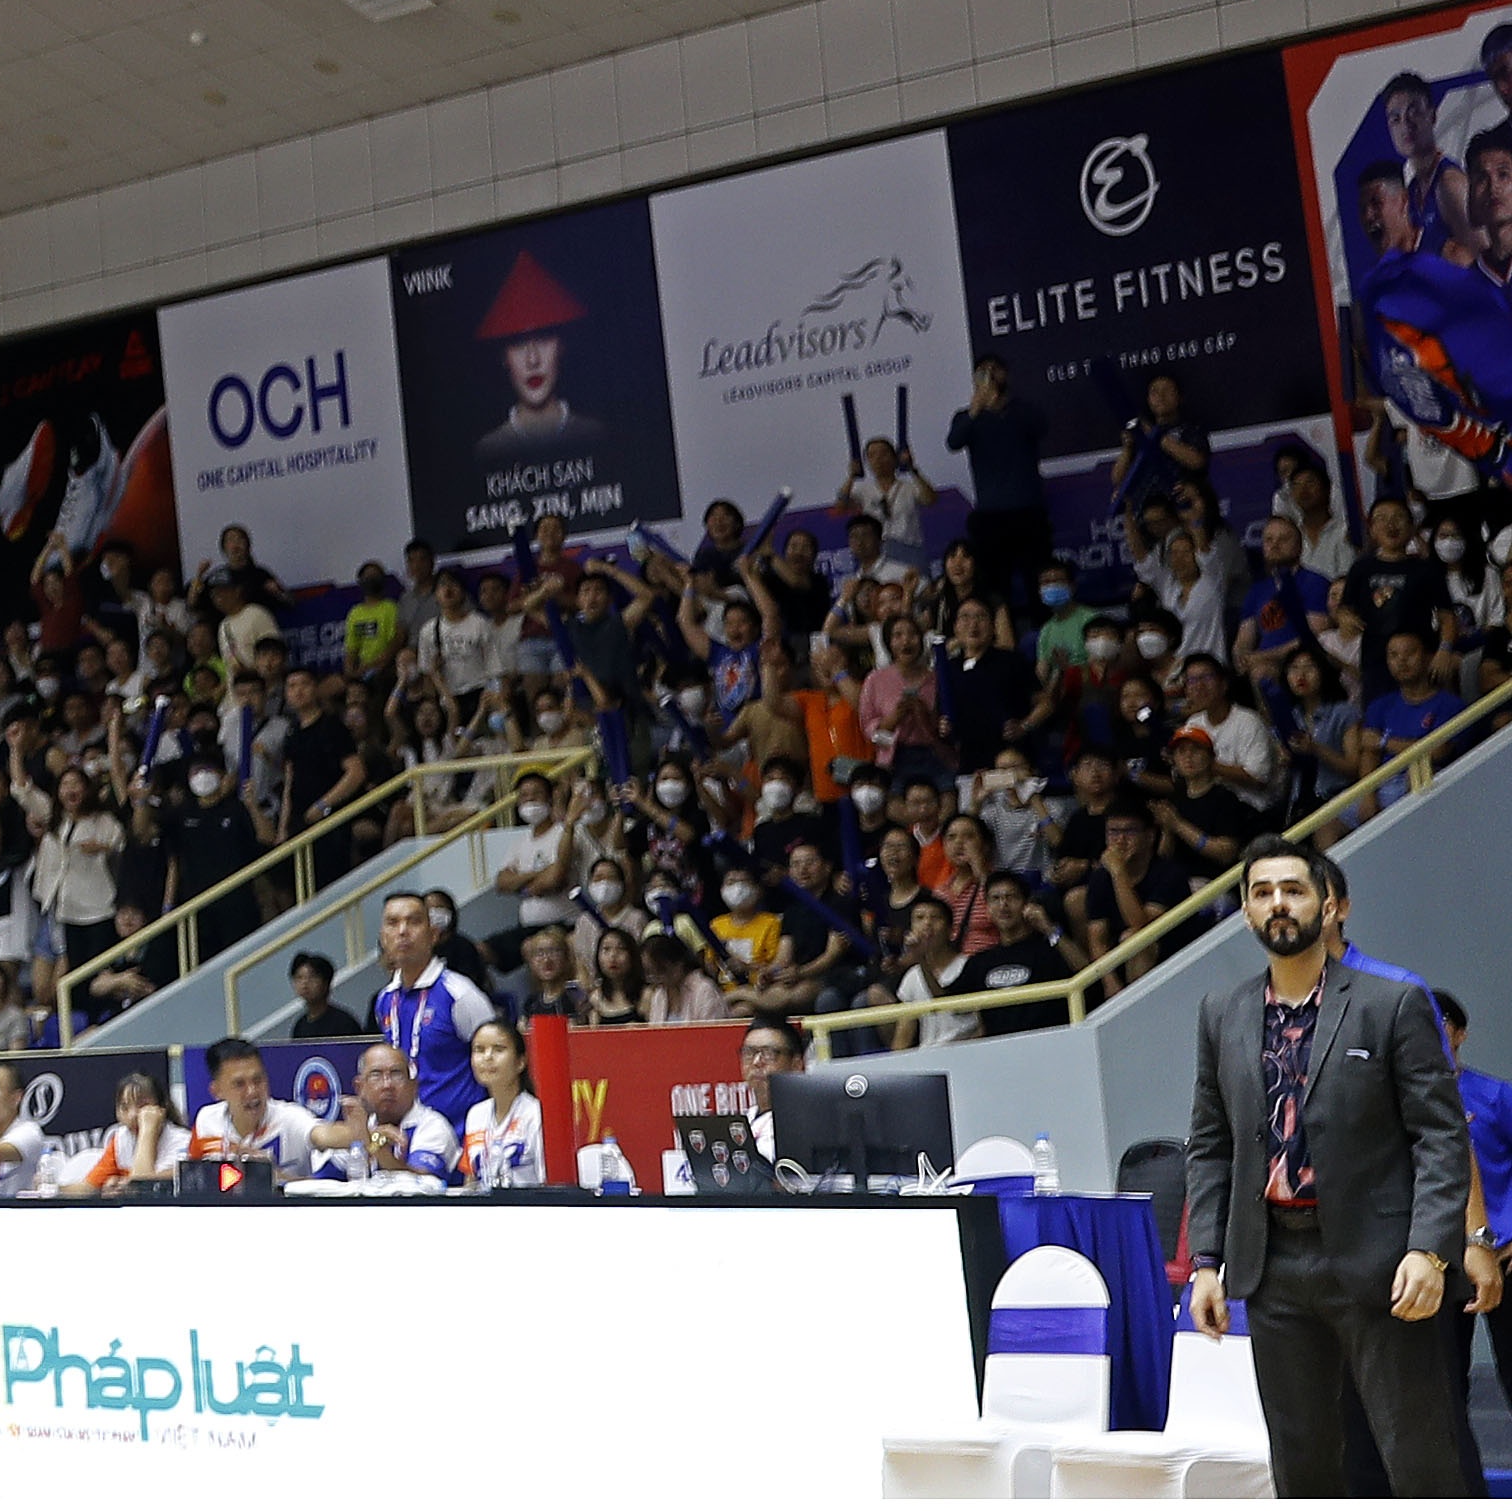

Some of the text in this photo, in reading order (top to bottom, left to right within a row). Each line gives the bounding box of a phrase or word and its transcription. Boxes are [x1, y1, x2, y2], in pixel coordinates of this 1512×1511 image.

[987, 241, 1286, 337] ELITE FITNESS
[699, 320, 868, 379] Leadvisors
[208, 350, 349, 449] OCH
[196, 438, 378, 491] ONE CAPITAL HOSPITALITY
[2, 1325, 182, 1442] Pháp
